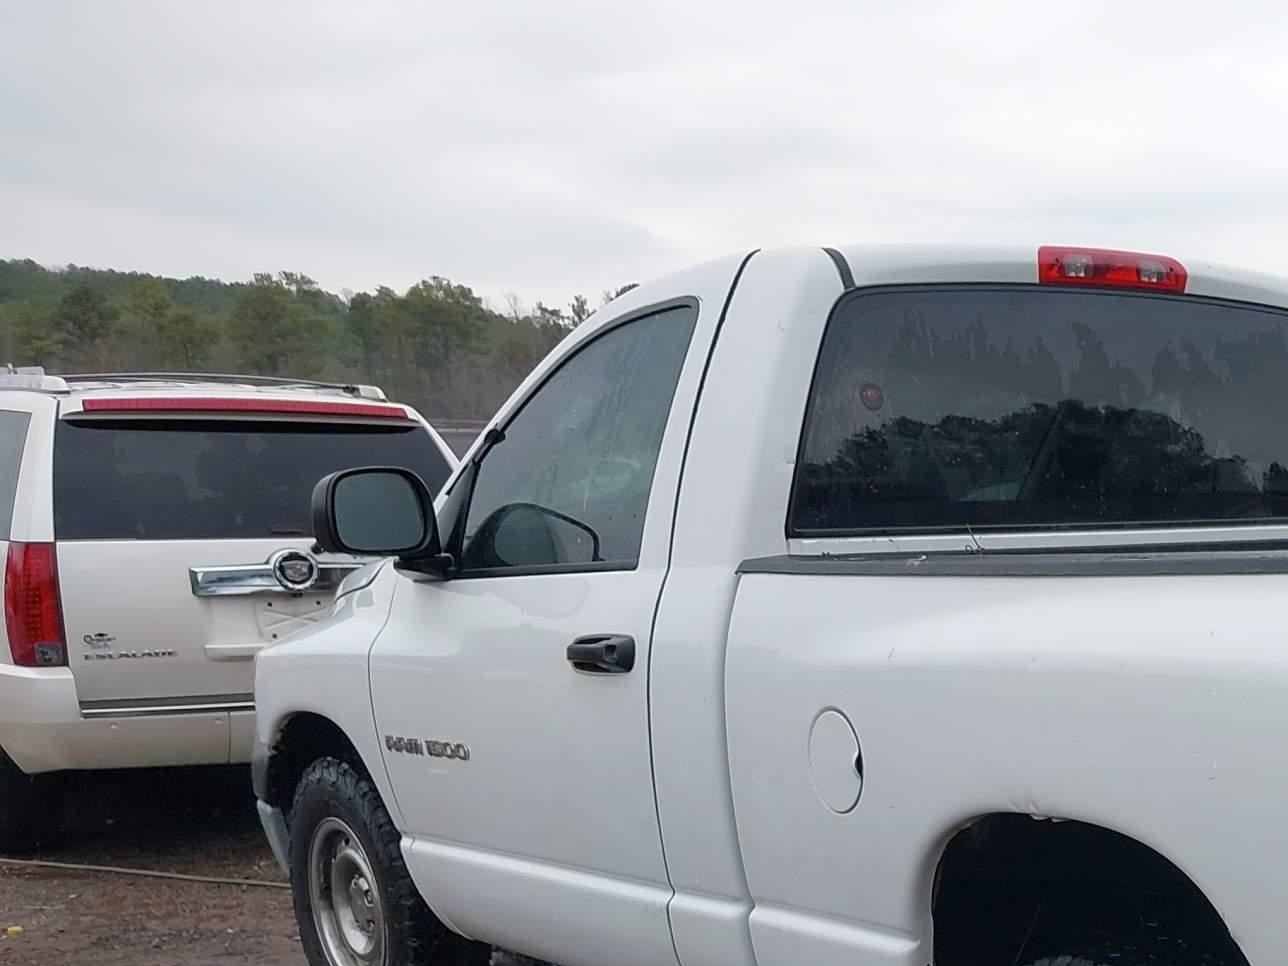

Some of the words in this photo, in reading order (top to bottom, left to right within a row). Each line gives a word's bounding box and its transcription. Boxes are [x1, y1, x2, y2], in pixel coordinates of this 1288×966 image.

[83, 650, 178, 661] ESCALADE
[384, 735, 424, 756] RAM
[424, 740, 470, 761] 1500
